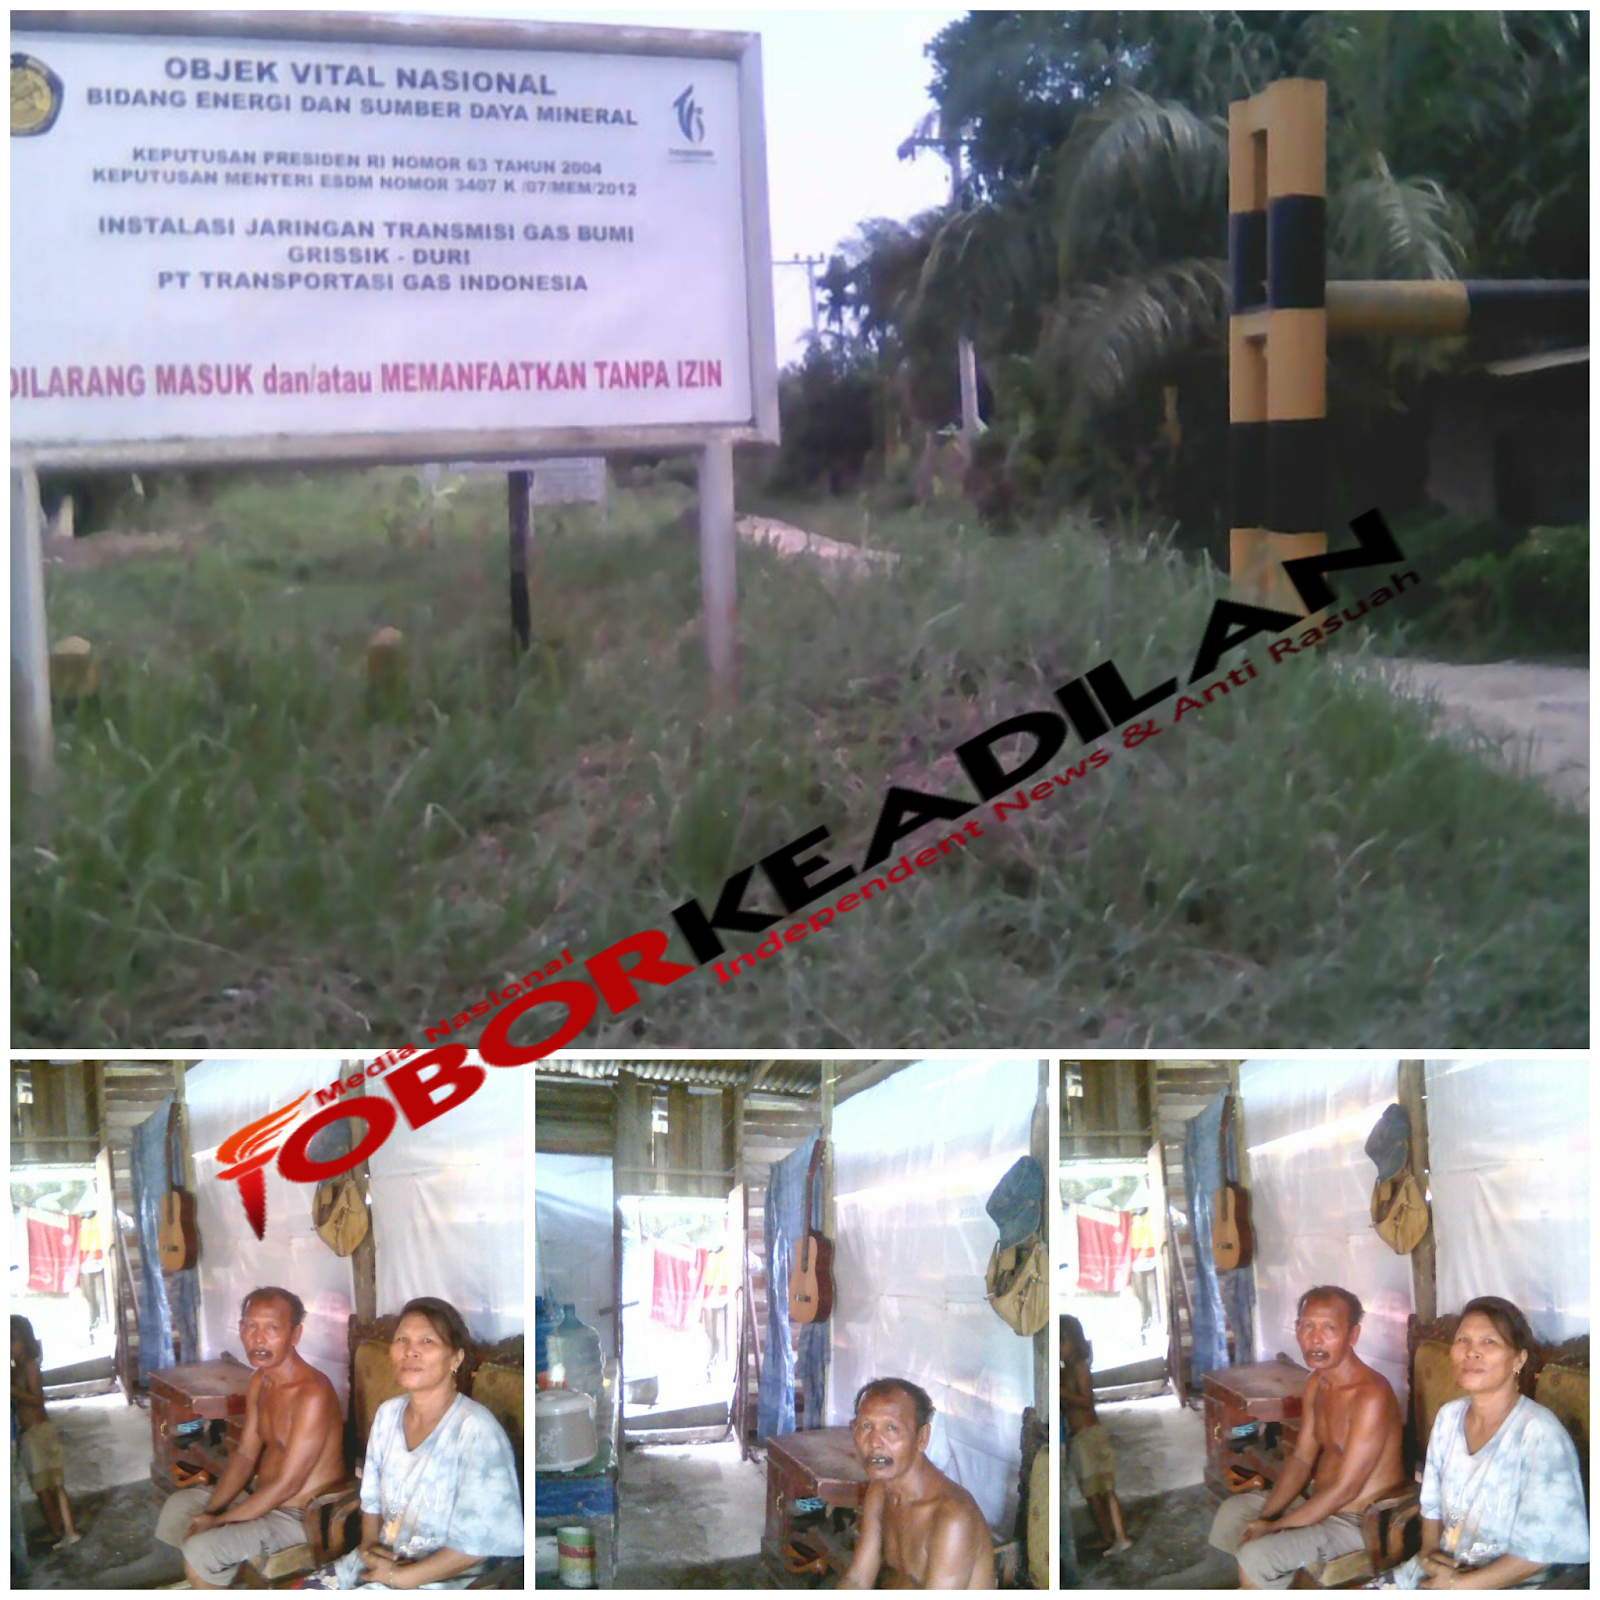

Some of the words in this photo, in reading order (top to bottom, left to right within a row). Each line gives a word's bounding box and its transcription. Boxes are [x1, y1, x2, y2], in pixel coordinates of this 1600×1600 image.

[165, 57, 278, 83] OBJEK
[291, 62, 384, 87] VITAL
[396, 67, 557, 95] NASIONAL
[87, 87, 187, 107] BIDANG
[196, 91, 291, 111] ENERGI
[301, 96, 350, 113] DAN
[361, 98, 461, 118] SUMBER
[470, 103, 529, 121] DAYA
[537, 106, 638, 125] MINERAL
[132, 147, 256, 165] KEPUTUSAN
[263, 150, 360, 168] PRESIDEN
[367, 154, 385, 169] RI
[392, 155, 460, 171] NOMOR
[467, 157, 487, 172] 63
[495, 159, 556, 174] TAHUN
[561, 160, 603, 175] 2004
[92, 168, 218, 185] KEPUTUSAN
[225, 171, 313, 187] MENTERI
[321, 174, 373, 189] ESDM
[380, 175, 448, 191] NOMOR
[455, 177, 497, 193] 3407
[503, 179, 516, 193] K
[99, 216, 235, 236] INSTALASI
[245, 218, 375, 238] JARINGAN
[384, 221, 515, 241] TRANSMISI
[523, 224, 570, 241] GAS
[577, 225, 634, 243] BUMI
[287, 245, 389, 264] GRISSIK
[412, 248, 470, 265] DURI
[158, 271, 191, 289] PT
[199, 271, 394, 290] TRANSPORTASI
[402, 273, 451, 291] GAS
[460, 274, 588, 292] INDONESIA
[156, 363, 254, 396] MASUK
[263, 363, 373, 395] dan/atau
[381, 360, 586, 393] MEMANFAATKAN
[594, 360, 670, 389] TANPA
[677, 359, 722, 388] IZIN
